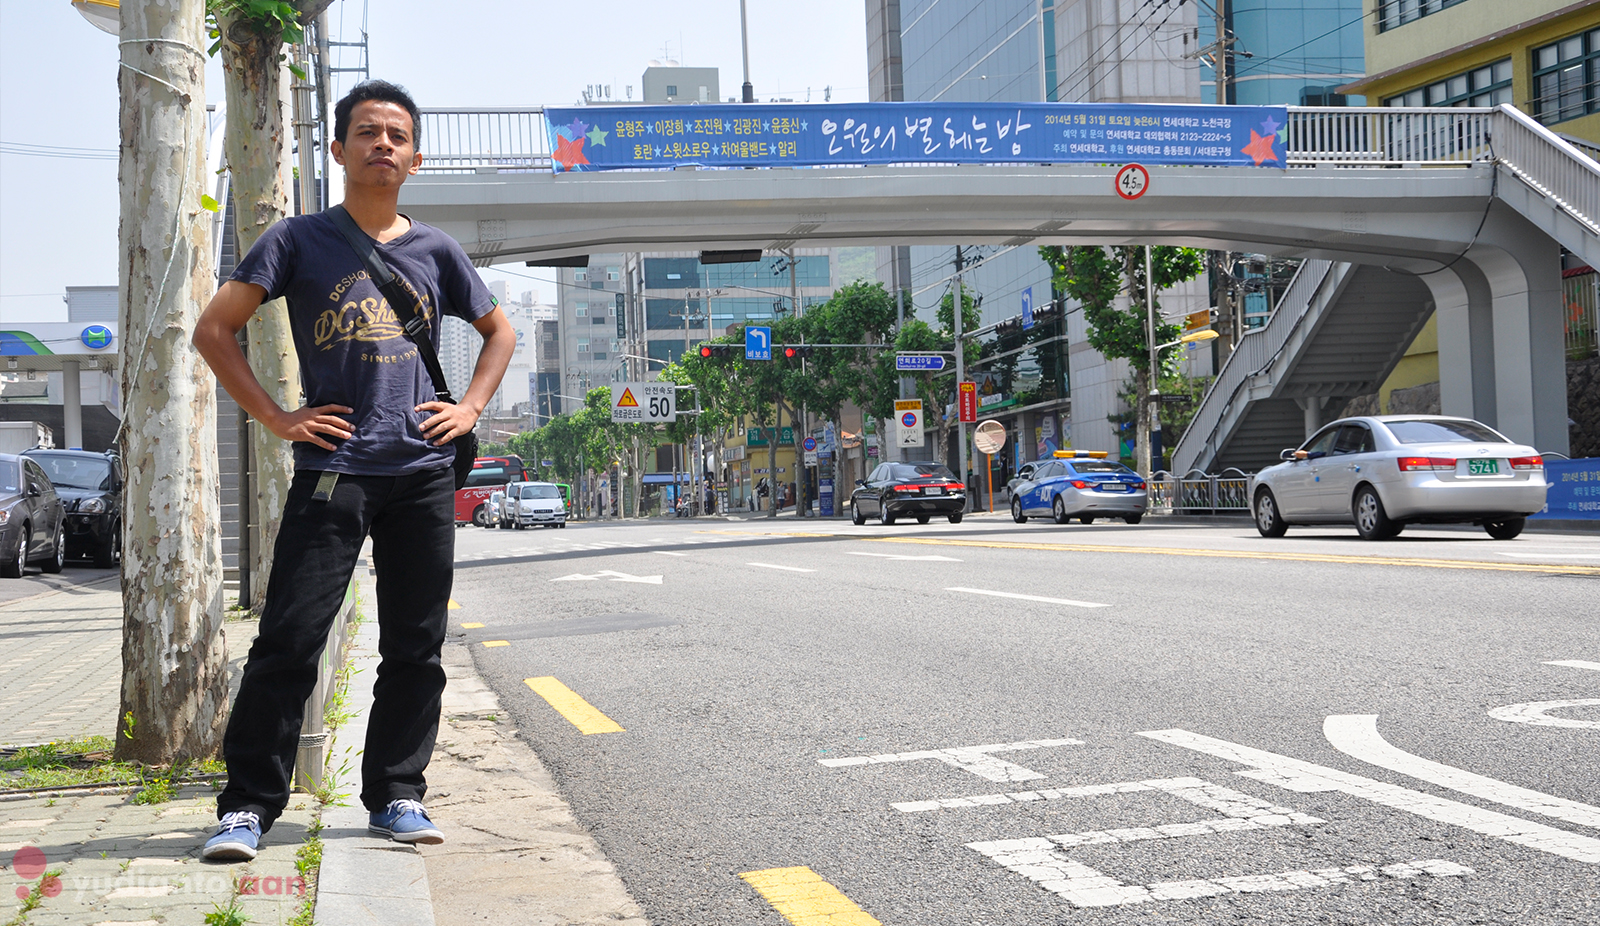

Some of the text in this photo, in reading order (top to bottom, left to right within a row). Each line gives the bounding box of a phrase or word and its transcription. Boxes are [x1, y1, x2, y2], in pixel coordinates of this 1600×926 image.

[615, 117, 800, 138] 윤형주 이장희 조진원 김광진 윤종신
[1044, 114, 1071, 125] 2014년
[1073, 114, 1086, 125] 5월
[1089, 115, 1106, 126] 31일
[1108, 115, 1131, 126] 토요일
[1163, 117, 1200, 128] 연세대학교
[1201, 117, 1231, 129] 노천극장
[996, 109, 1032, 155] 밤
[1106, 129, 1141, 140] 연세대학교
[633, 140, 797, 161] 호란 스윗소로우 차여울밴드 알리
[361, 352, 397, 364] SINCE
[747, 350, 769, 358] 비보호
[644, 386, 674, 395] 안전속도
[649, 397, 670, 418] 50
[1470, 464, 1496, 474] 3741
